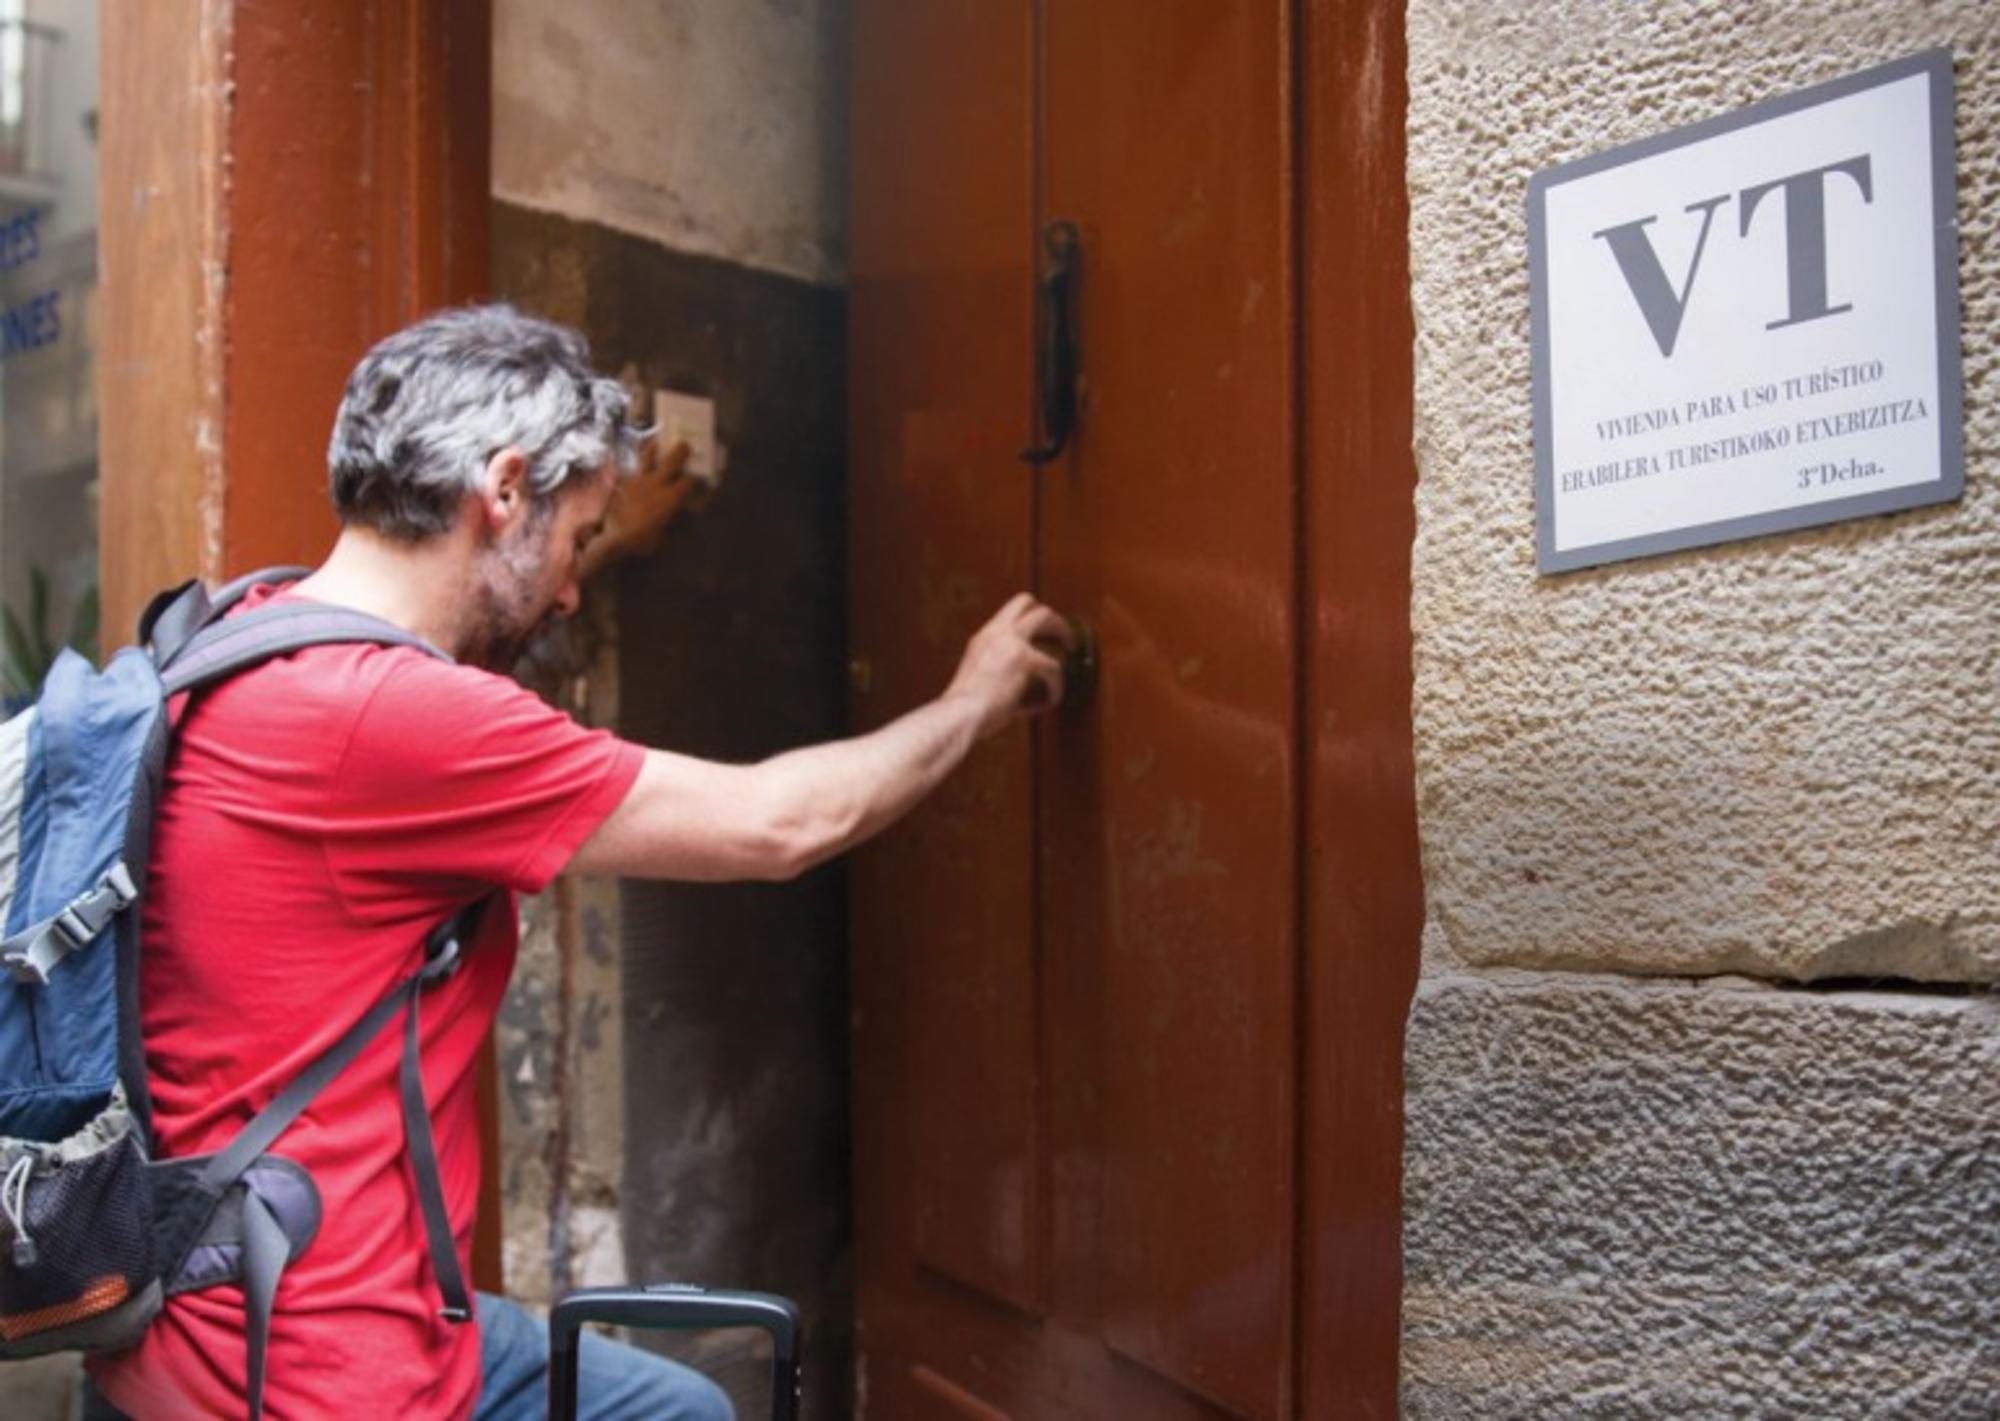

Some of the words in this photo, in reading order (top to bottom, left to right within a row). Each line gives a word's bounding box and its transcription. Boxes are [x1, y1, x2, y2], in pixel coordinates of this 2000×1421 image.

[1592, 153, 1873, 358] VT
[1561, 456, 1661, 493] ERABILERA
[1667, 427, 1791, 470] TURISTIKOKO
[1796, 397, 1929, 445] ETXEBIZITZA
[1596, 411, 1681, 441] VIVIENDA
[1686, 395, 1736, 424] PARA
[1741, 384, 1778, 409] USO
[1783, 358, 1884, 402] TURÍSTICO
